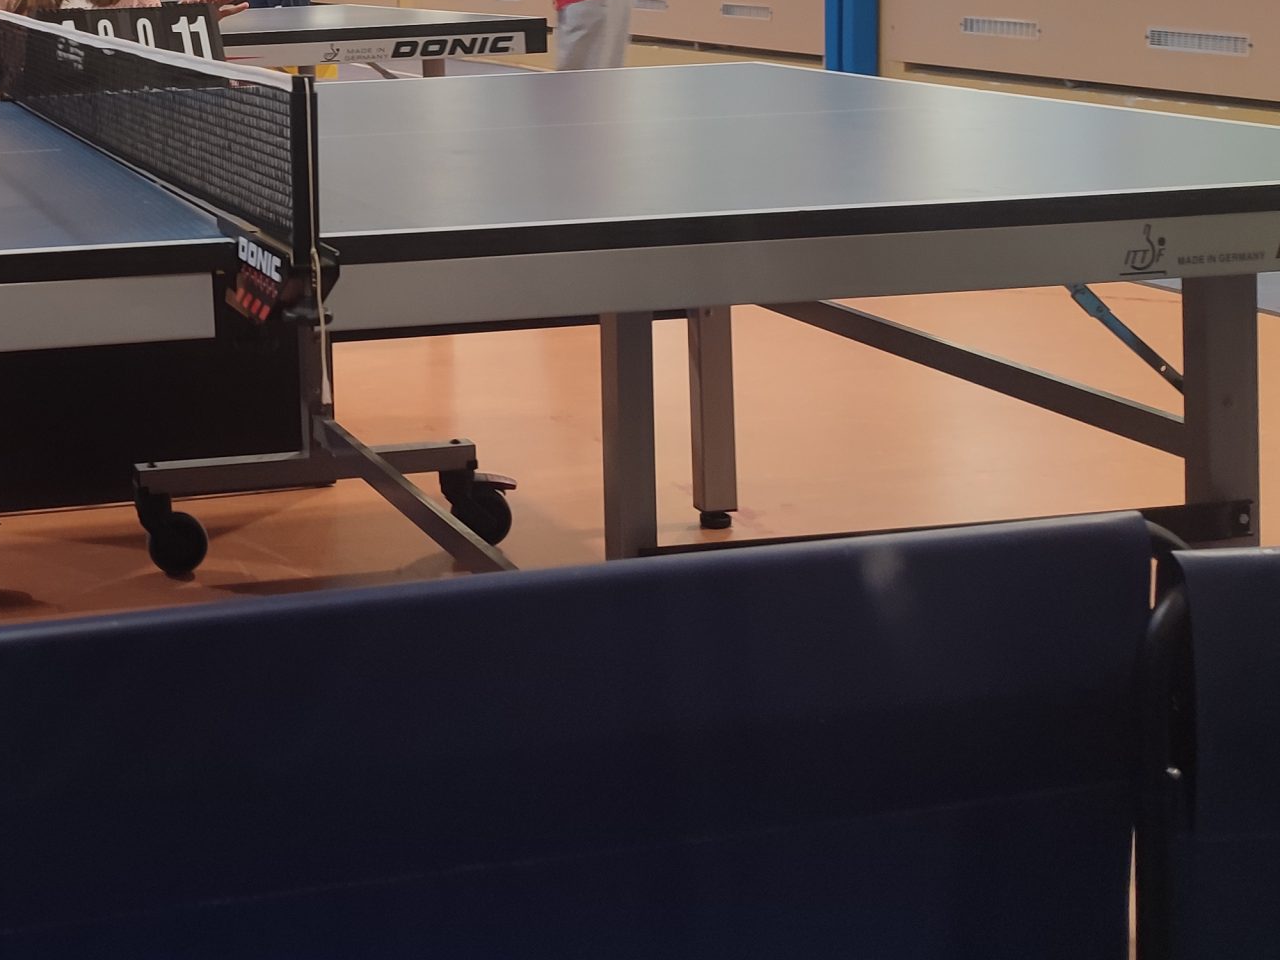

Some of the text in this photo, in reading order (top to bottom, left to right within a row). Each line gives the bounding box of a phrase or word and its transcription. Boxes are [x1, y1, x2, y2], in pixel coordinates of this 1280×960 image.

[171, 16, 213, 61] 11
[391, 35, 514, 58] DONIC
[238, 235, 282, 283] DONIC
[1177, 255, 1205, 265] MADE
[1207, 254, 1216, 264] IN
[1218, 252, 1266, 263] GERMANY
